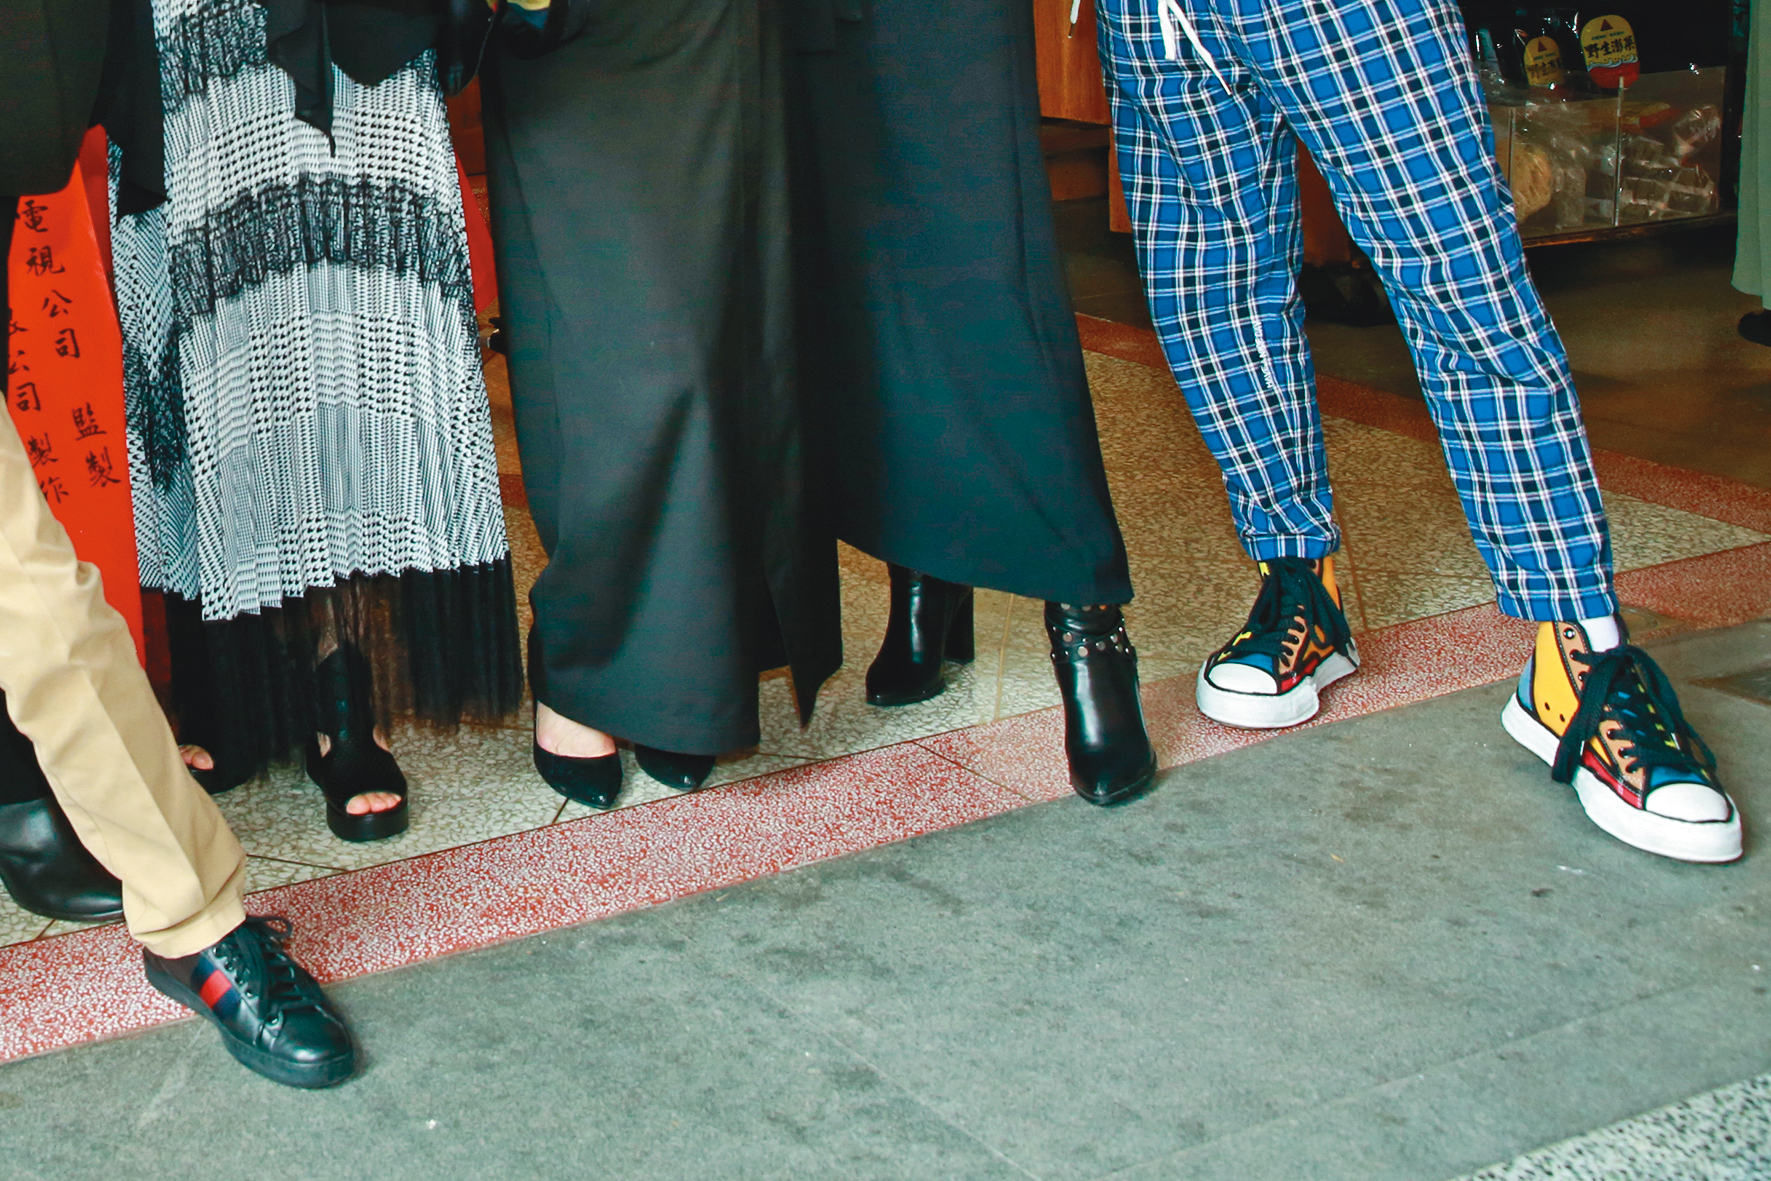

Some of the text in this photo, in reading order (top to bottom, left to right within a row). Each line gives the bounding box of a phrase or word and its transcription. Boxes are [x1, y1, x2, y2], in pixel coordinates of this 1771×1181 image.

[16, 199, 121, 488] 電視公司 監製
